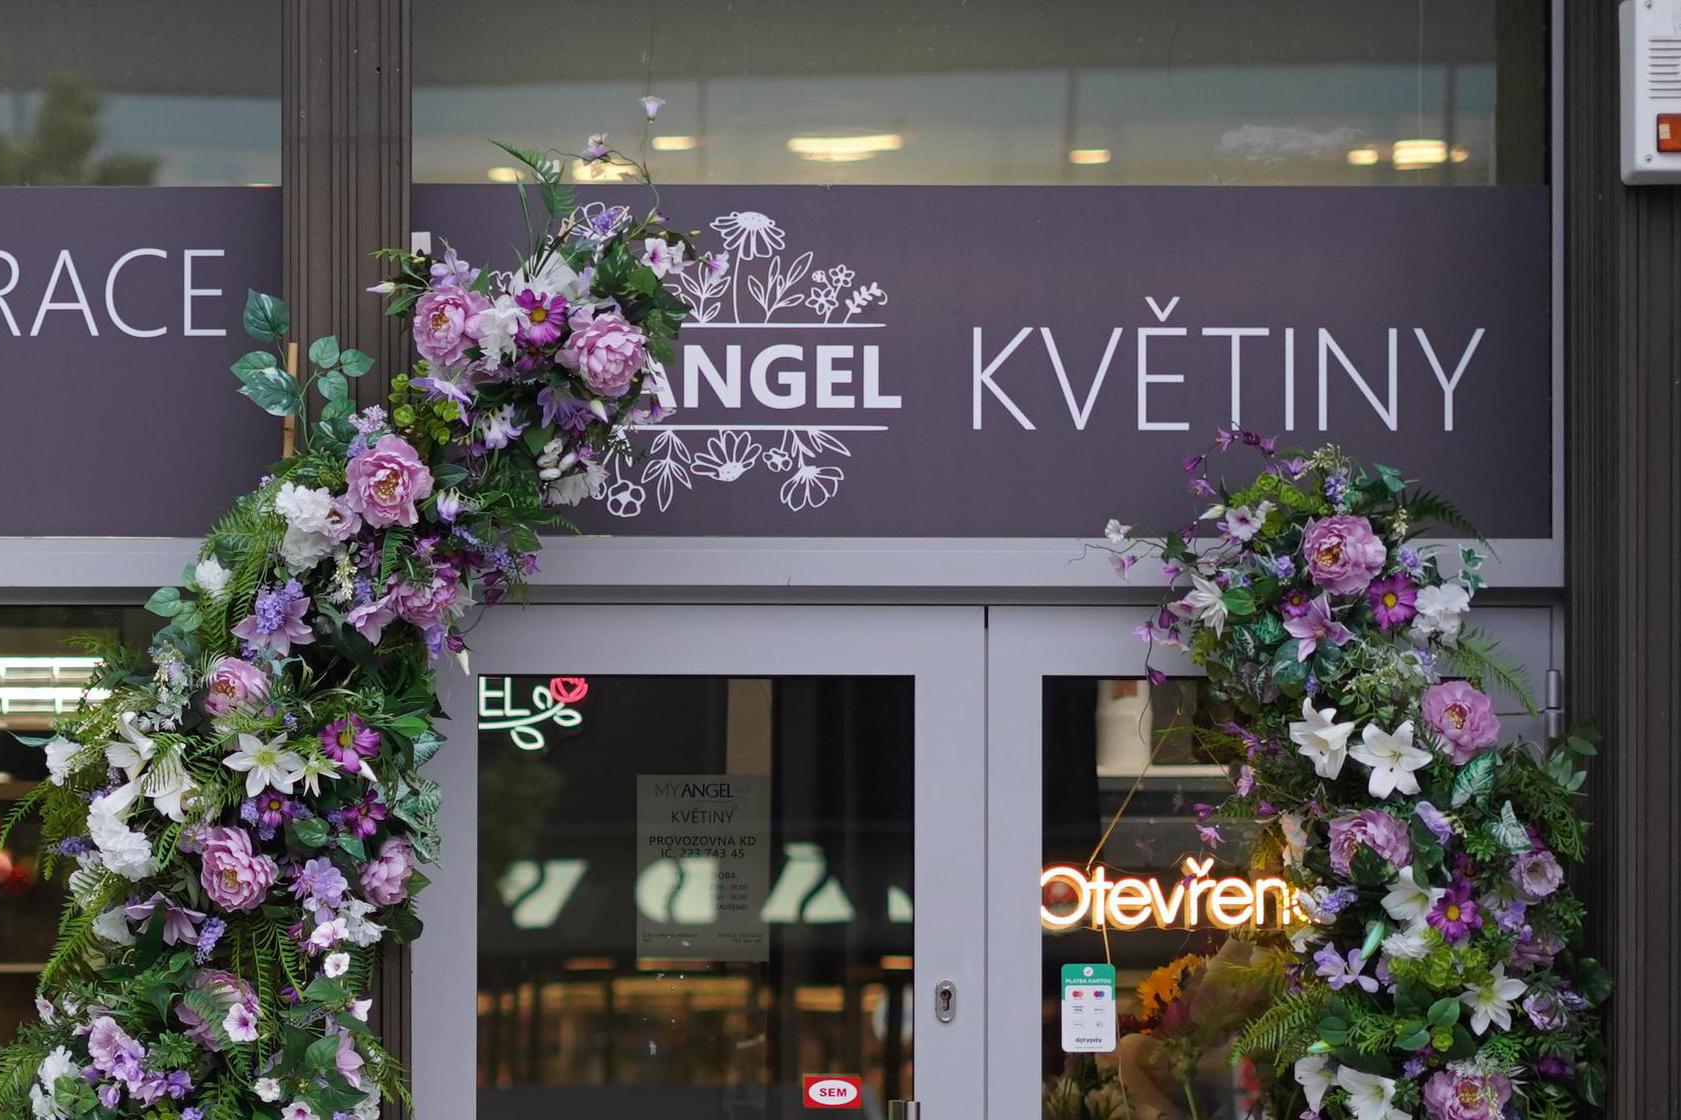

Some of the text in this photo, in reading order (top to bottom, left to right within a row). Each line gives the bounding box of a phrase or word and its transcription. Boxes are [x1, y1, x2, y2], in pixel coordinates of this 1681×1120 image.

[972, 296, 1485, 431] KVĚTINY
[671, 807, 735, 824] KVĚTINY
[649, 835, 756, 847] PROVOZOVNA KD
[731, 848, 745, 859] 45
[819, 1087, 848, 1098] SEM
